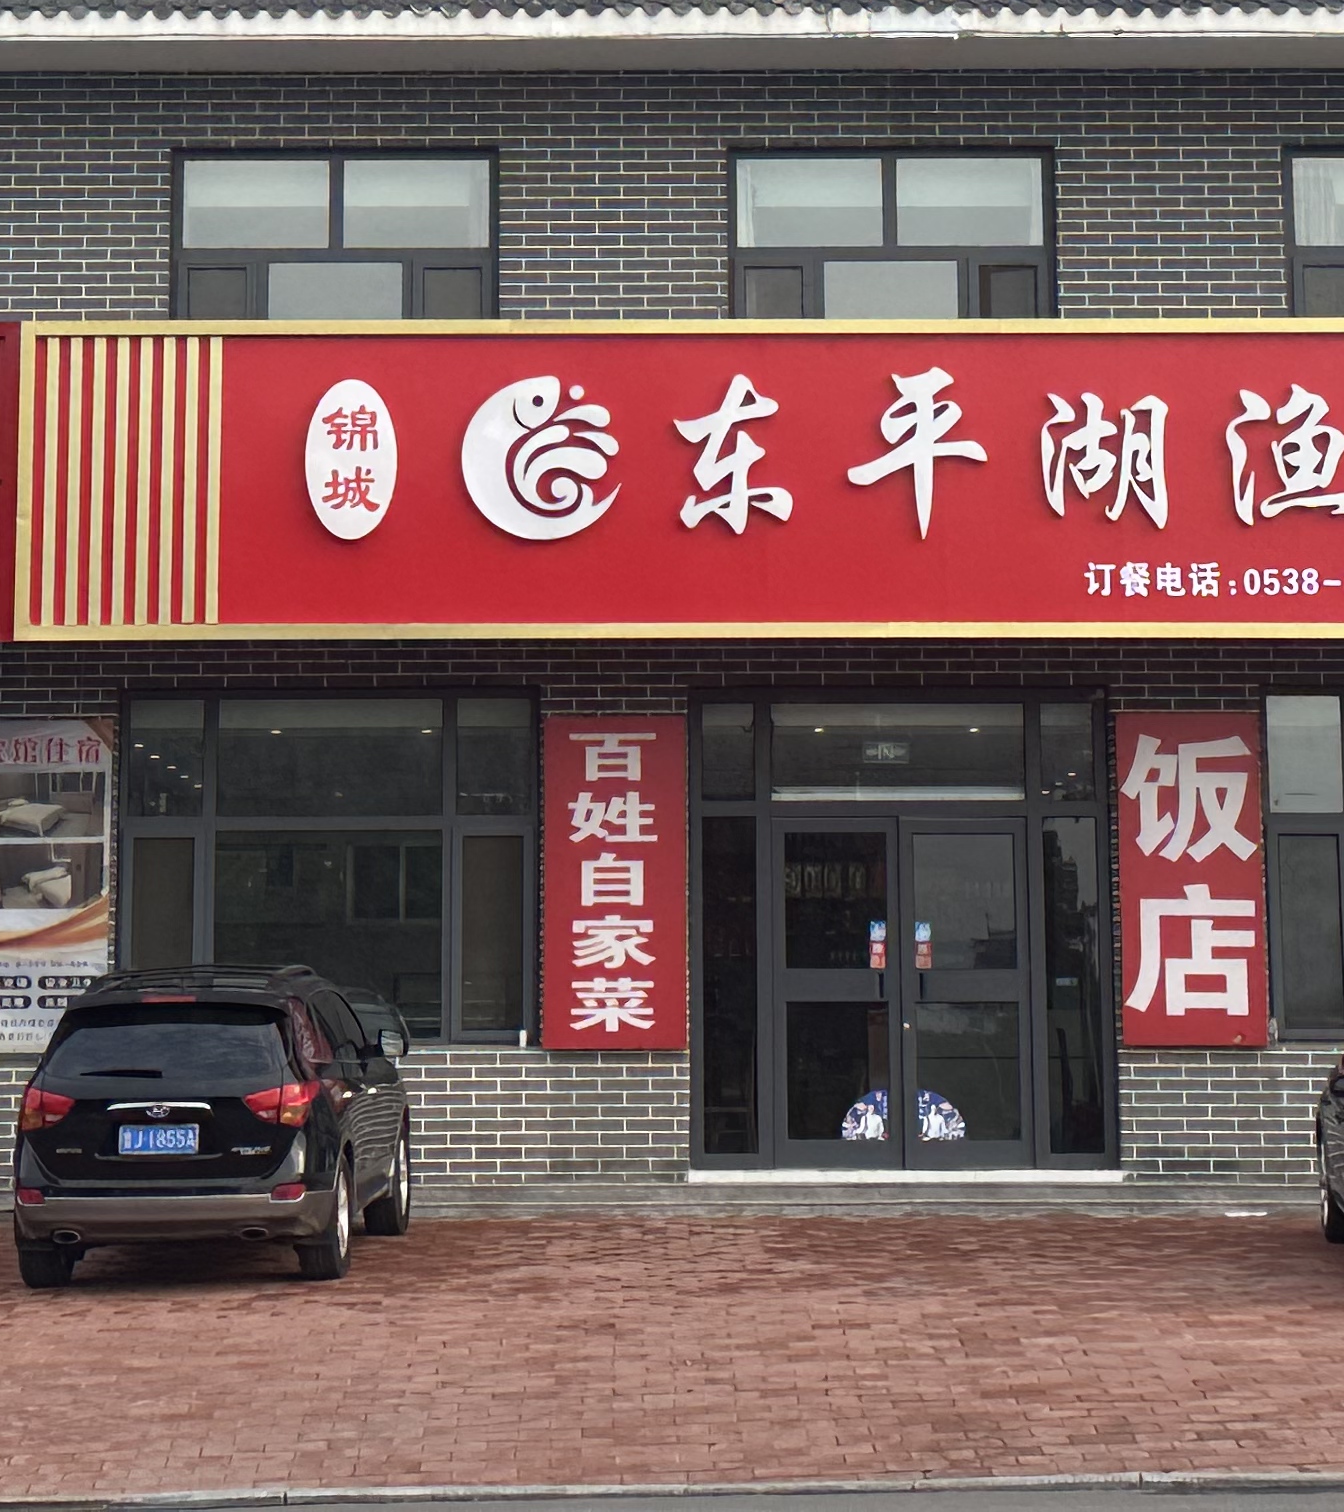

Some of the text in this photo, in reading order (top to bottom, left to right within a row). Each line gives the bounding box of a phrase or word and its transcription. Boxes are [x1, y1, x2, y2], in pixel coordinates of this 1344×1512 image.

[321, 404, 381, 513] 锦城
[567, 731, 659, 1034] 百姓自家菜
[1119, 733, 1259, 1018] 饭店
